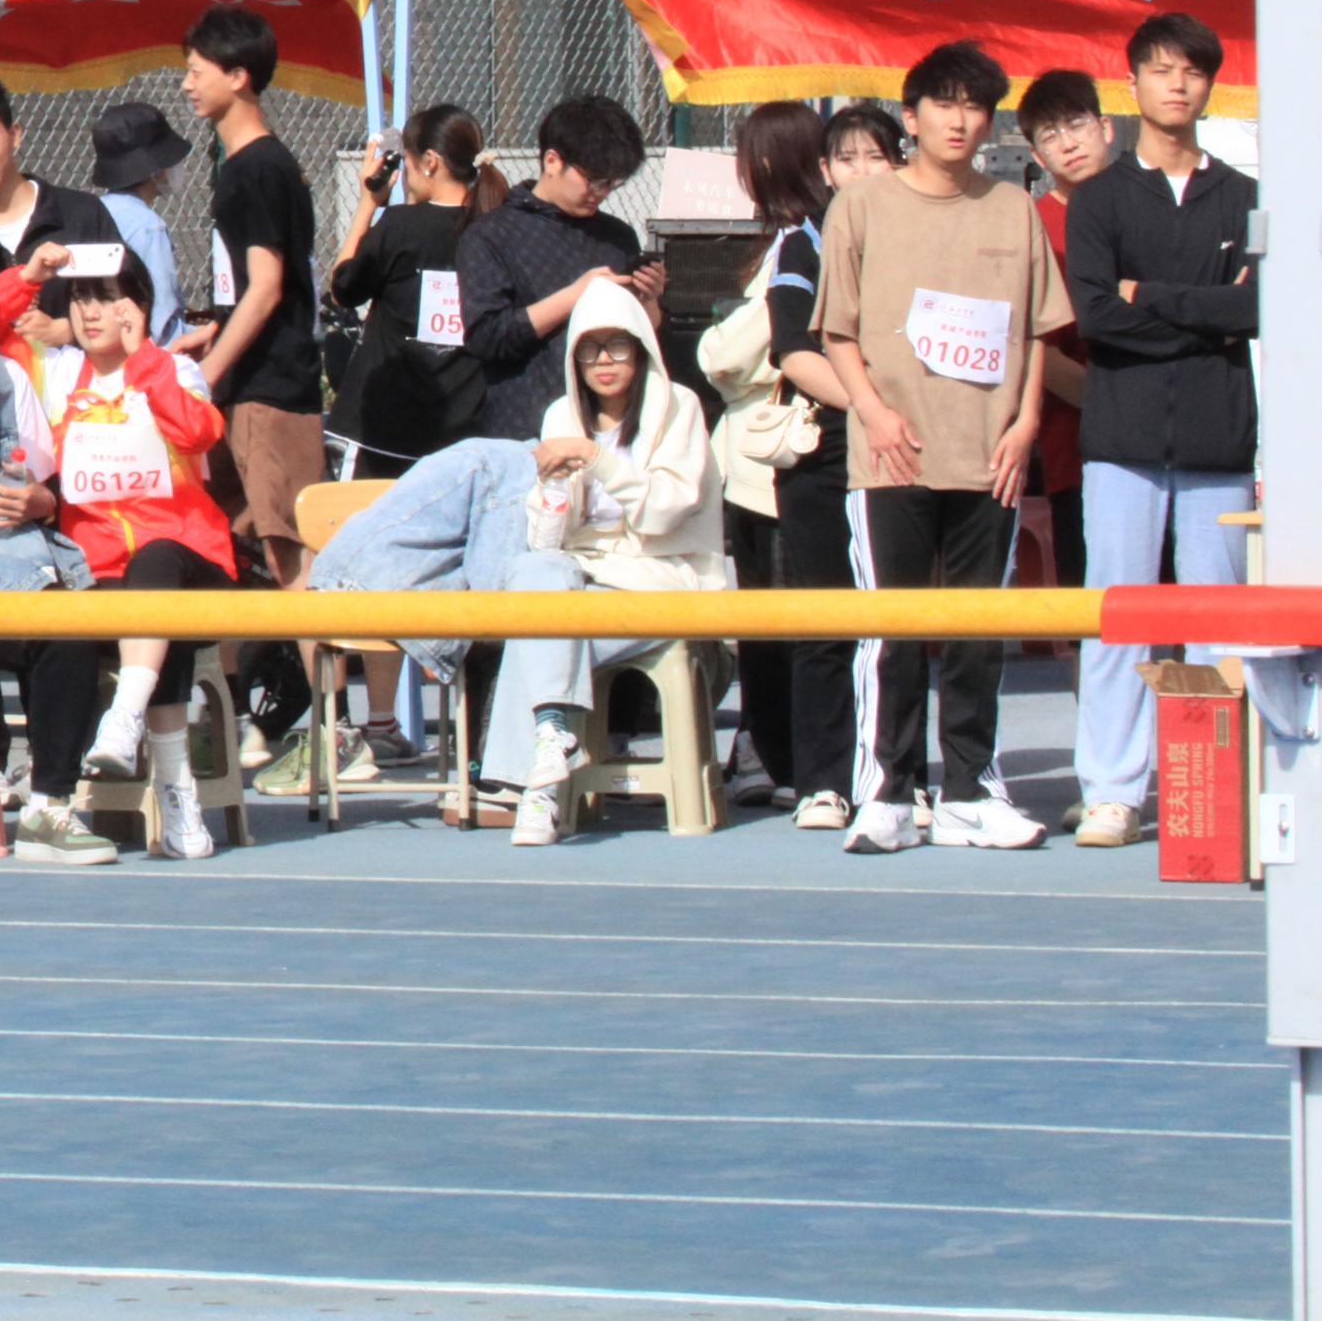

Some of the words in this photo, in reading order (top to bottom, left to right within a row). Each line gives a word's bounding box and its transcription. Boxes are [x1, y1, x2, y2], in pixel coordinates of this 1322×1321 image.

[917, 335, 1001, 372] 01028
[74, 469, 162, 493] 06127
[1192, 742, 1204, 786] SPRING
[1166, 742, 1189, 838] 农夫山泉
[1192, 790, 1205, 838] NONGFU
